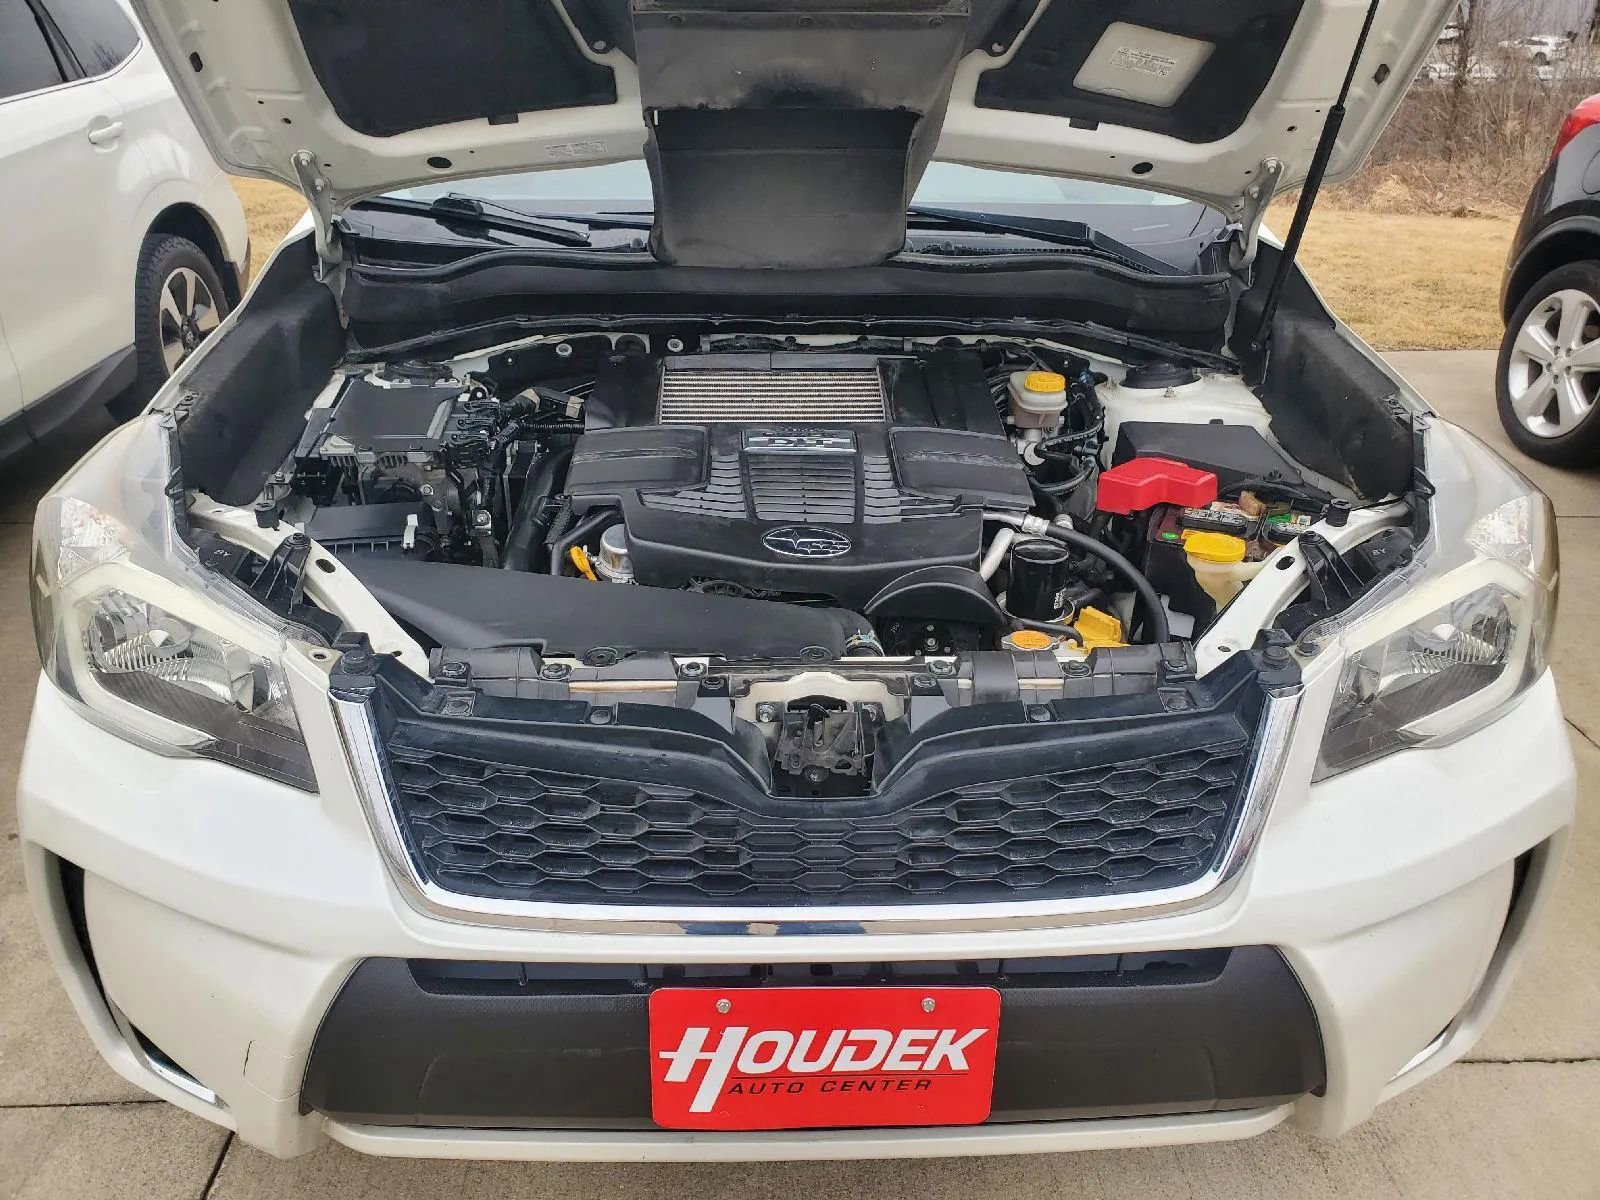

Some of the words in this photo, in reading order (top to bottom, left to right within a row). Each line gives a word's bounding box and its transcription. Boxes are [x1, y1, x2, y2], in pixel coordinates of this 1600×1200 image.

[659, 1026, 990, 1113] HOUDEK
[727, 1081, 805, 1095] AUTO
[820, 1079, 932, 1093] CENTER
